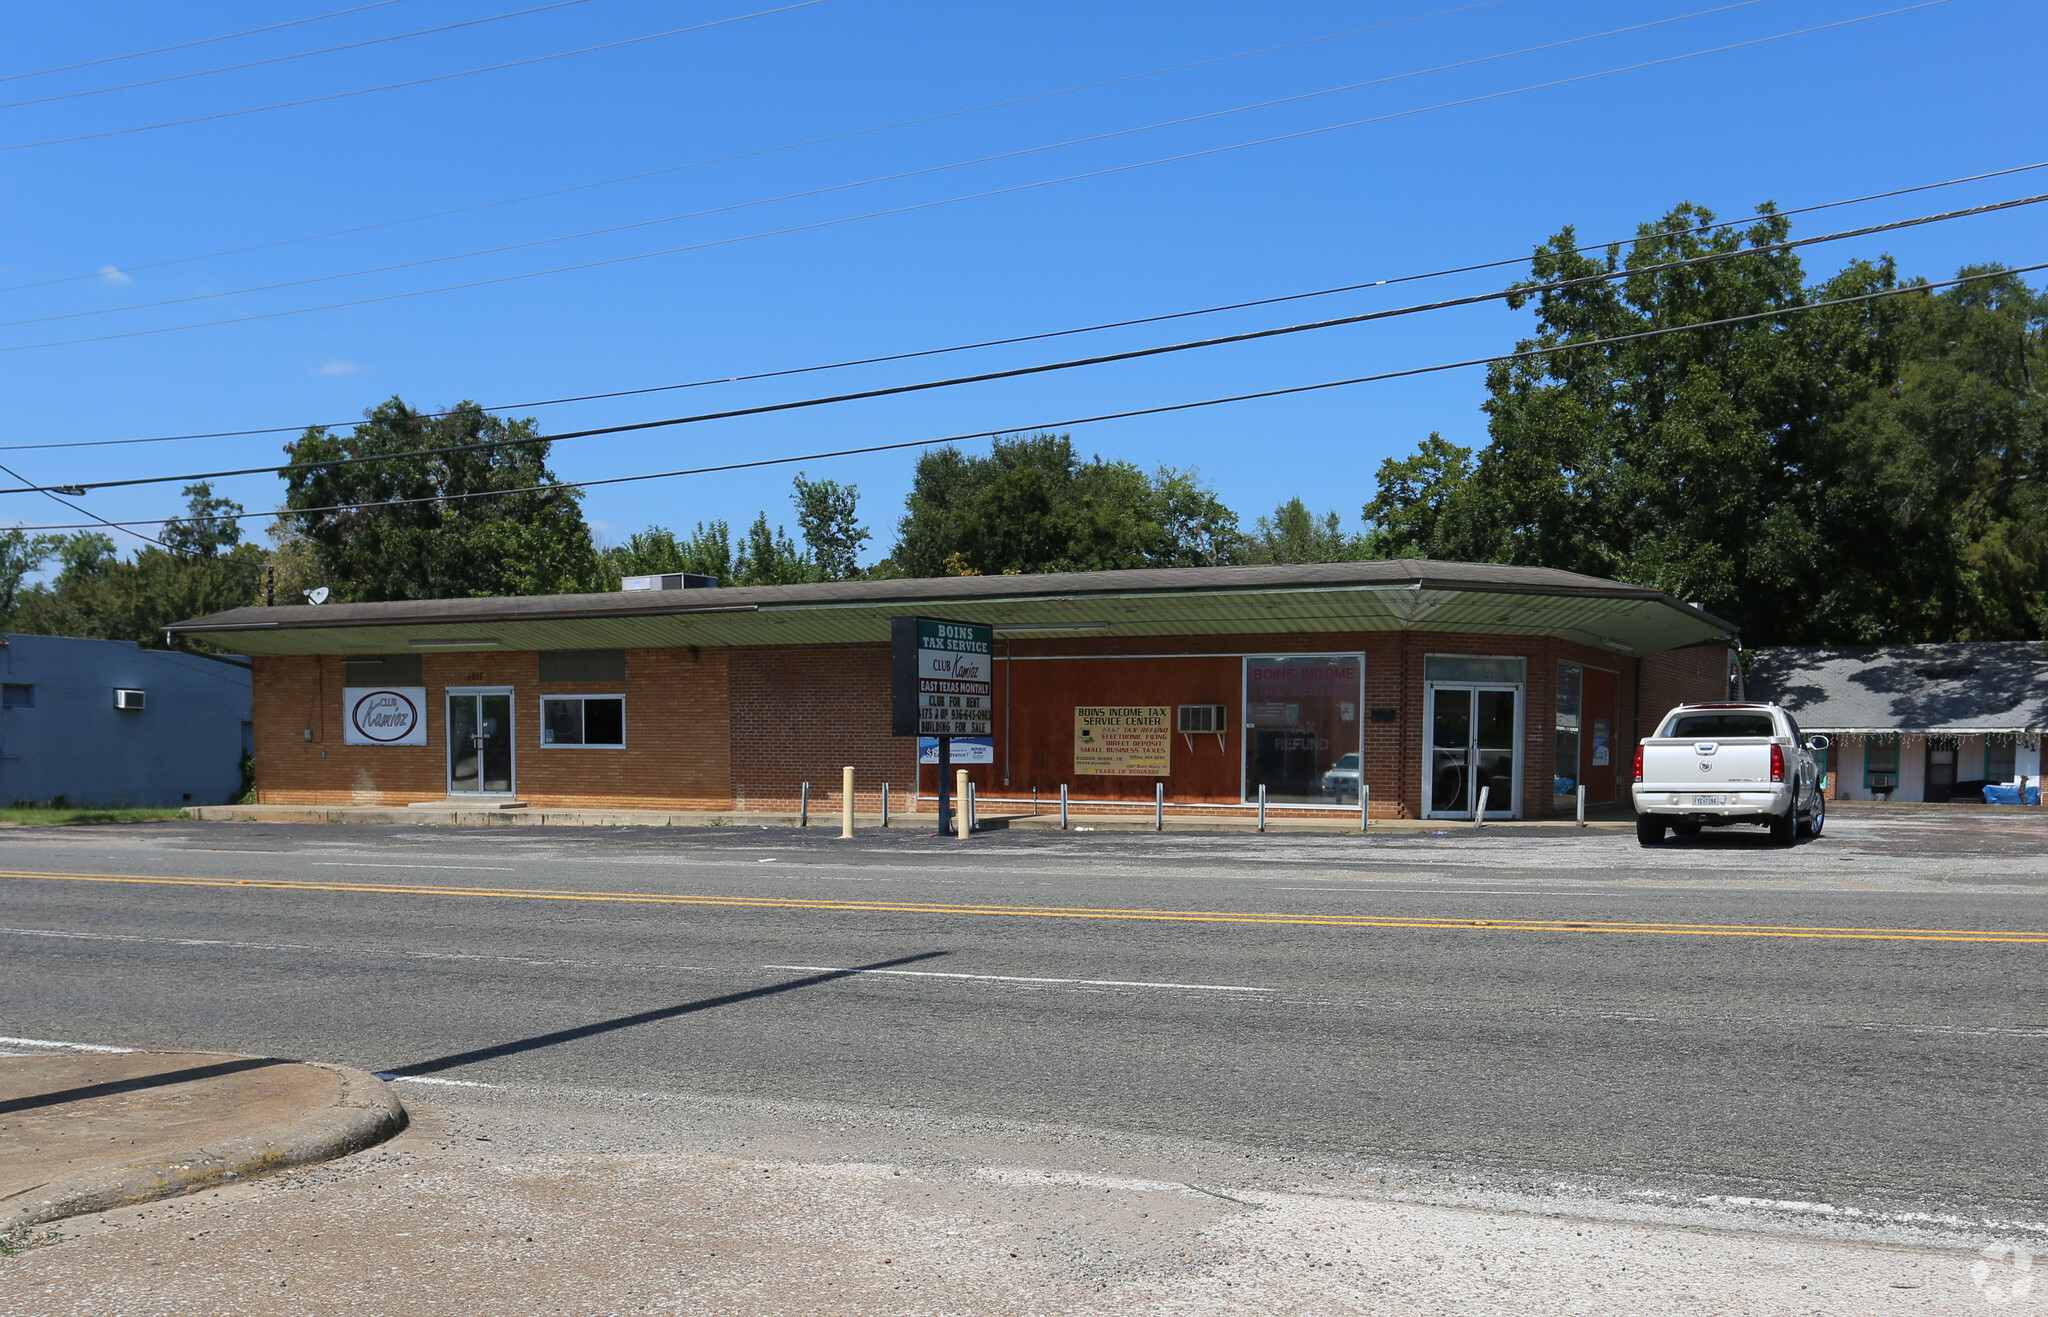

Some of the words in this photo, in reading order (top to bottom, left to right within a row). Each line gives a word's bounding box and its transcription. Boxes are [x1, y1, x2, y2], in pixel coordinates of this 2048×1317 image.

[938, 624, 973, 640] BOINS
[923, 637, 944, 648] TAX
[947, 640, 988, 652] SERVICE
[933, 659, 950, 672] CLUB
[1254, 668, 1294, 680] BOINS
[1302, 668, 1355, 680] INCOME
[921, 680, 938, 692] EAST
[940, 682, 958, 692] TEXAS
[960, 682, 988, 694] MONTHLY
[380, 698, 398, 706] CLUB
[929, 696, 944, 707] CLUB
[949, 696, 960, 708] FOR
[966, 697, 980, 708] RENT
[941, 709, 948, 720] UP
[1078, 708, 1105, 716] BOINS
[1110, 708, 1142, 716] INCOME
[1148, 708, 1166, 716] TAX
[922, 721, 950, 732] BUILDING
[955, 722, 966, 732] FOR
[972, 722, 986, 733] SALE
[1084, 717, 1120, 725] SERVICE
[1126, 717, 1160, 725] CENTER
[1289, 722, 1316, 734] TAX
[1275, 738, 1330, 750] REFUND
